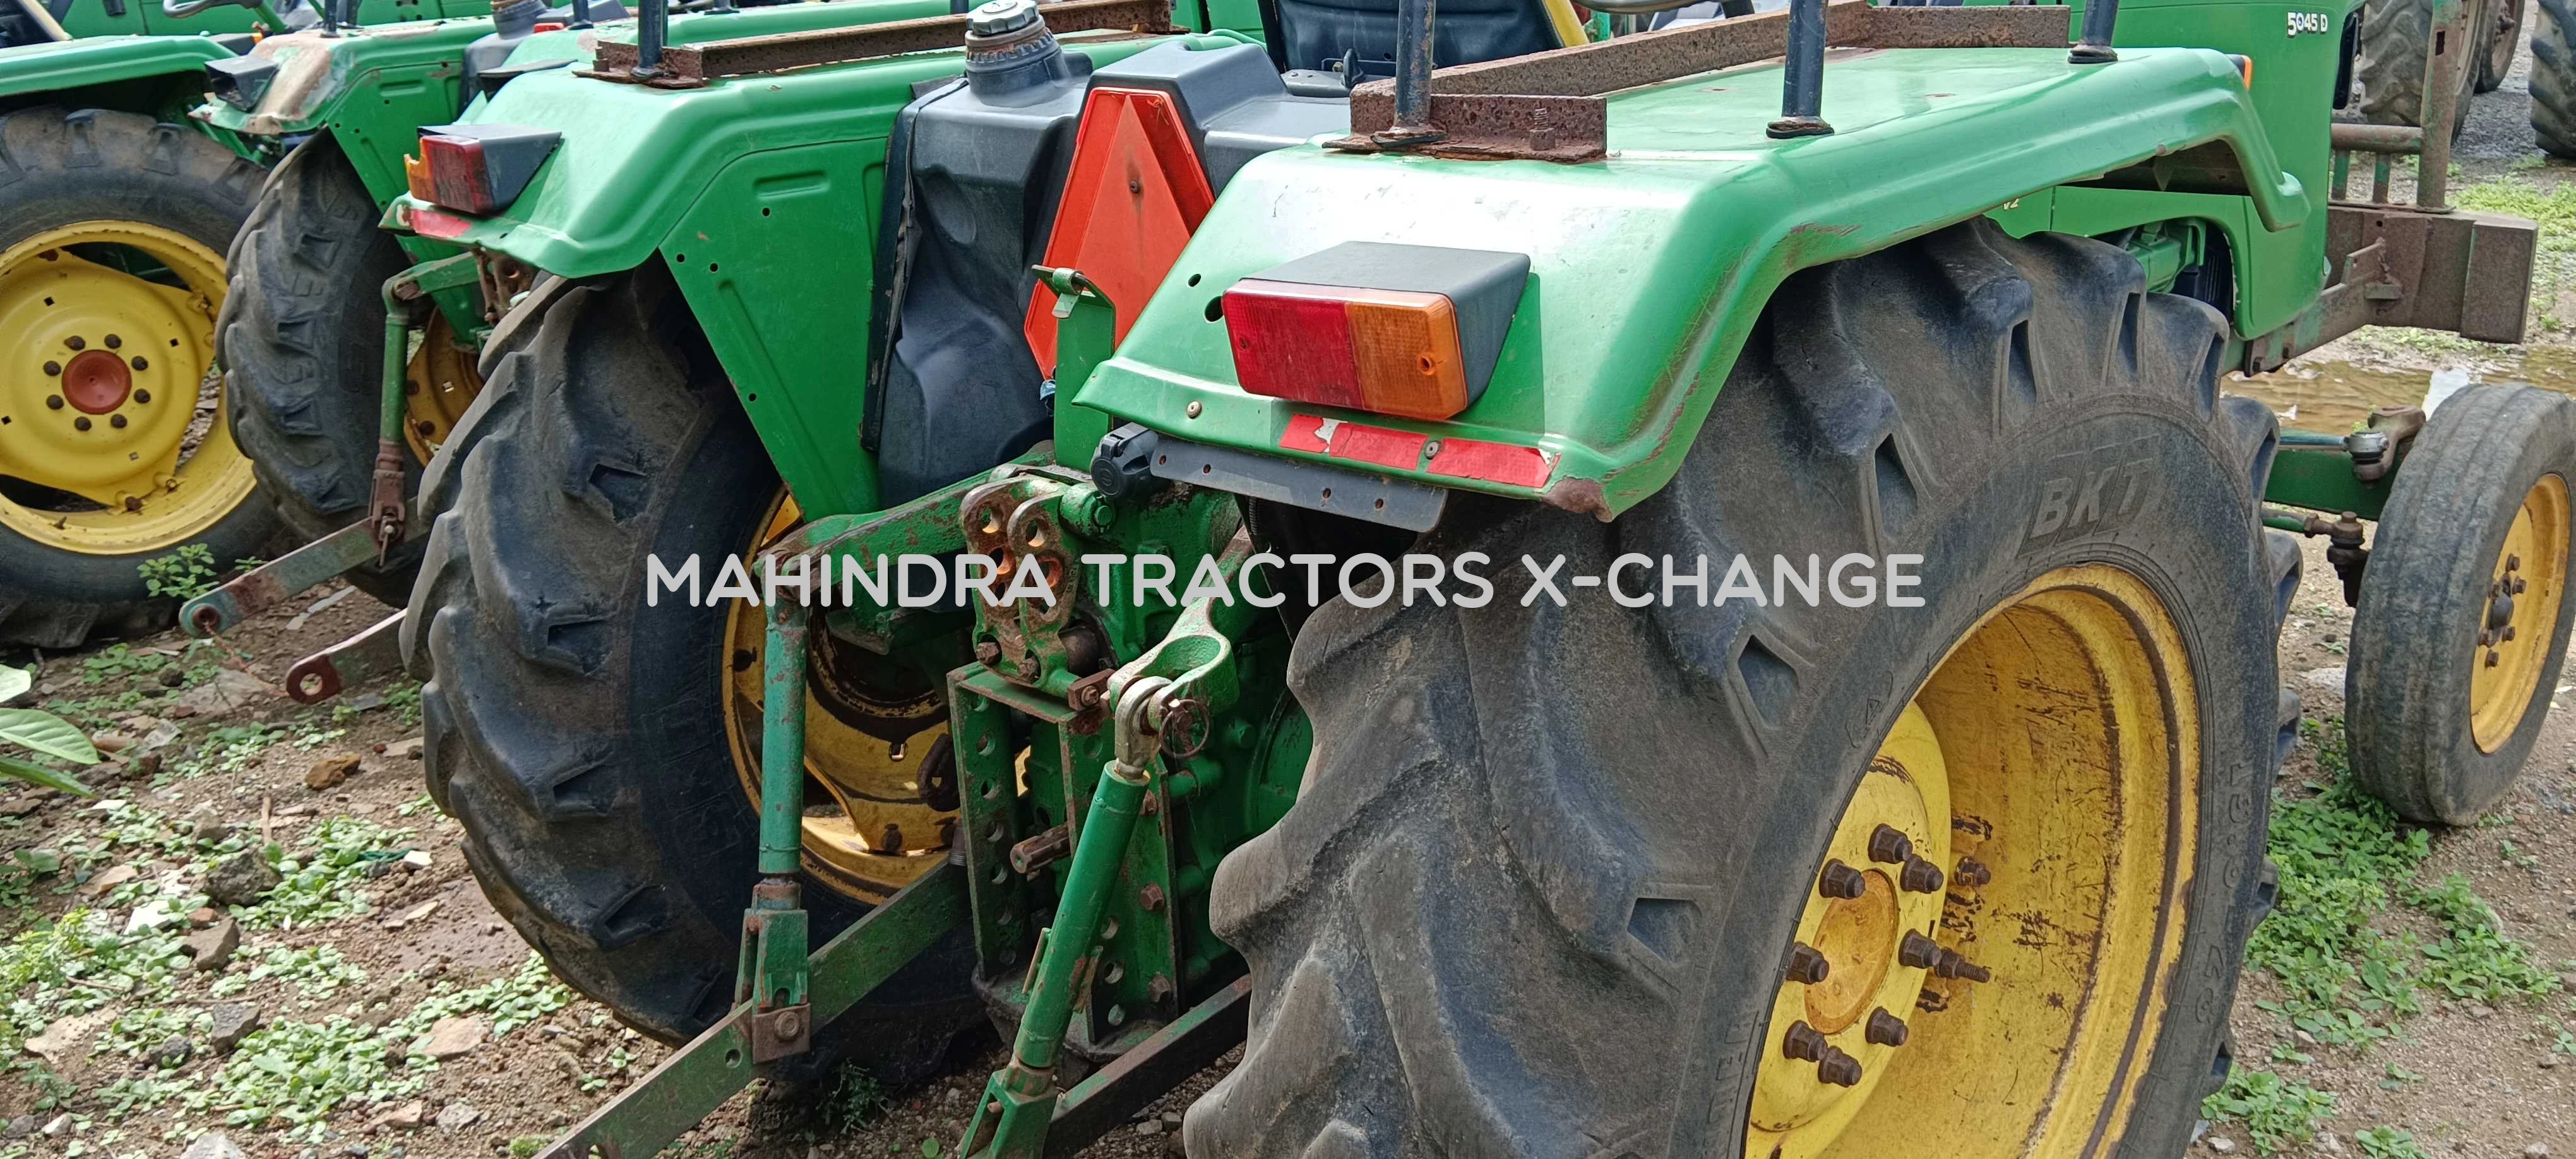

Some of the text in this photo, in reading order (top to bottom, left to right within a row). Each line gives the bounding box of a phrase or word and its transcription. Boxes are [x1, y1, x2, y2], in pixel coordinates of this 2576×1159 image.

[2287, 11, 2329, 37] 5045 D
[2028, 460, 2153, 539] BKT
